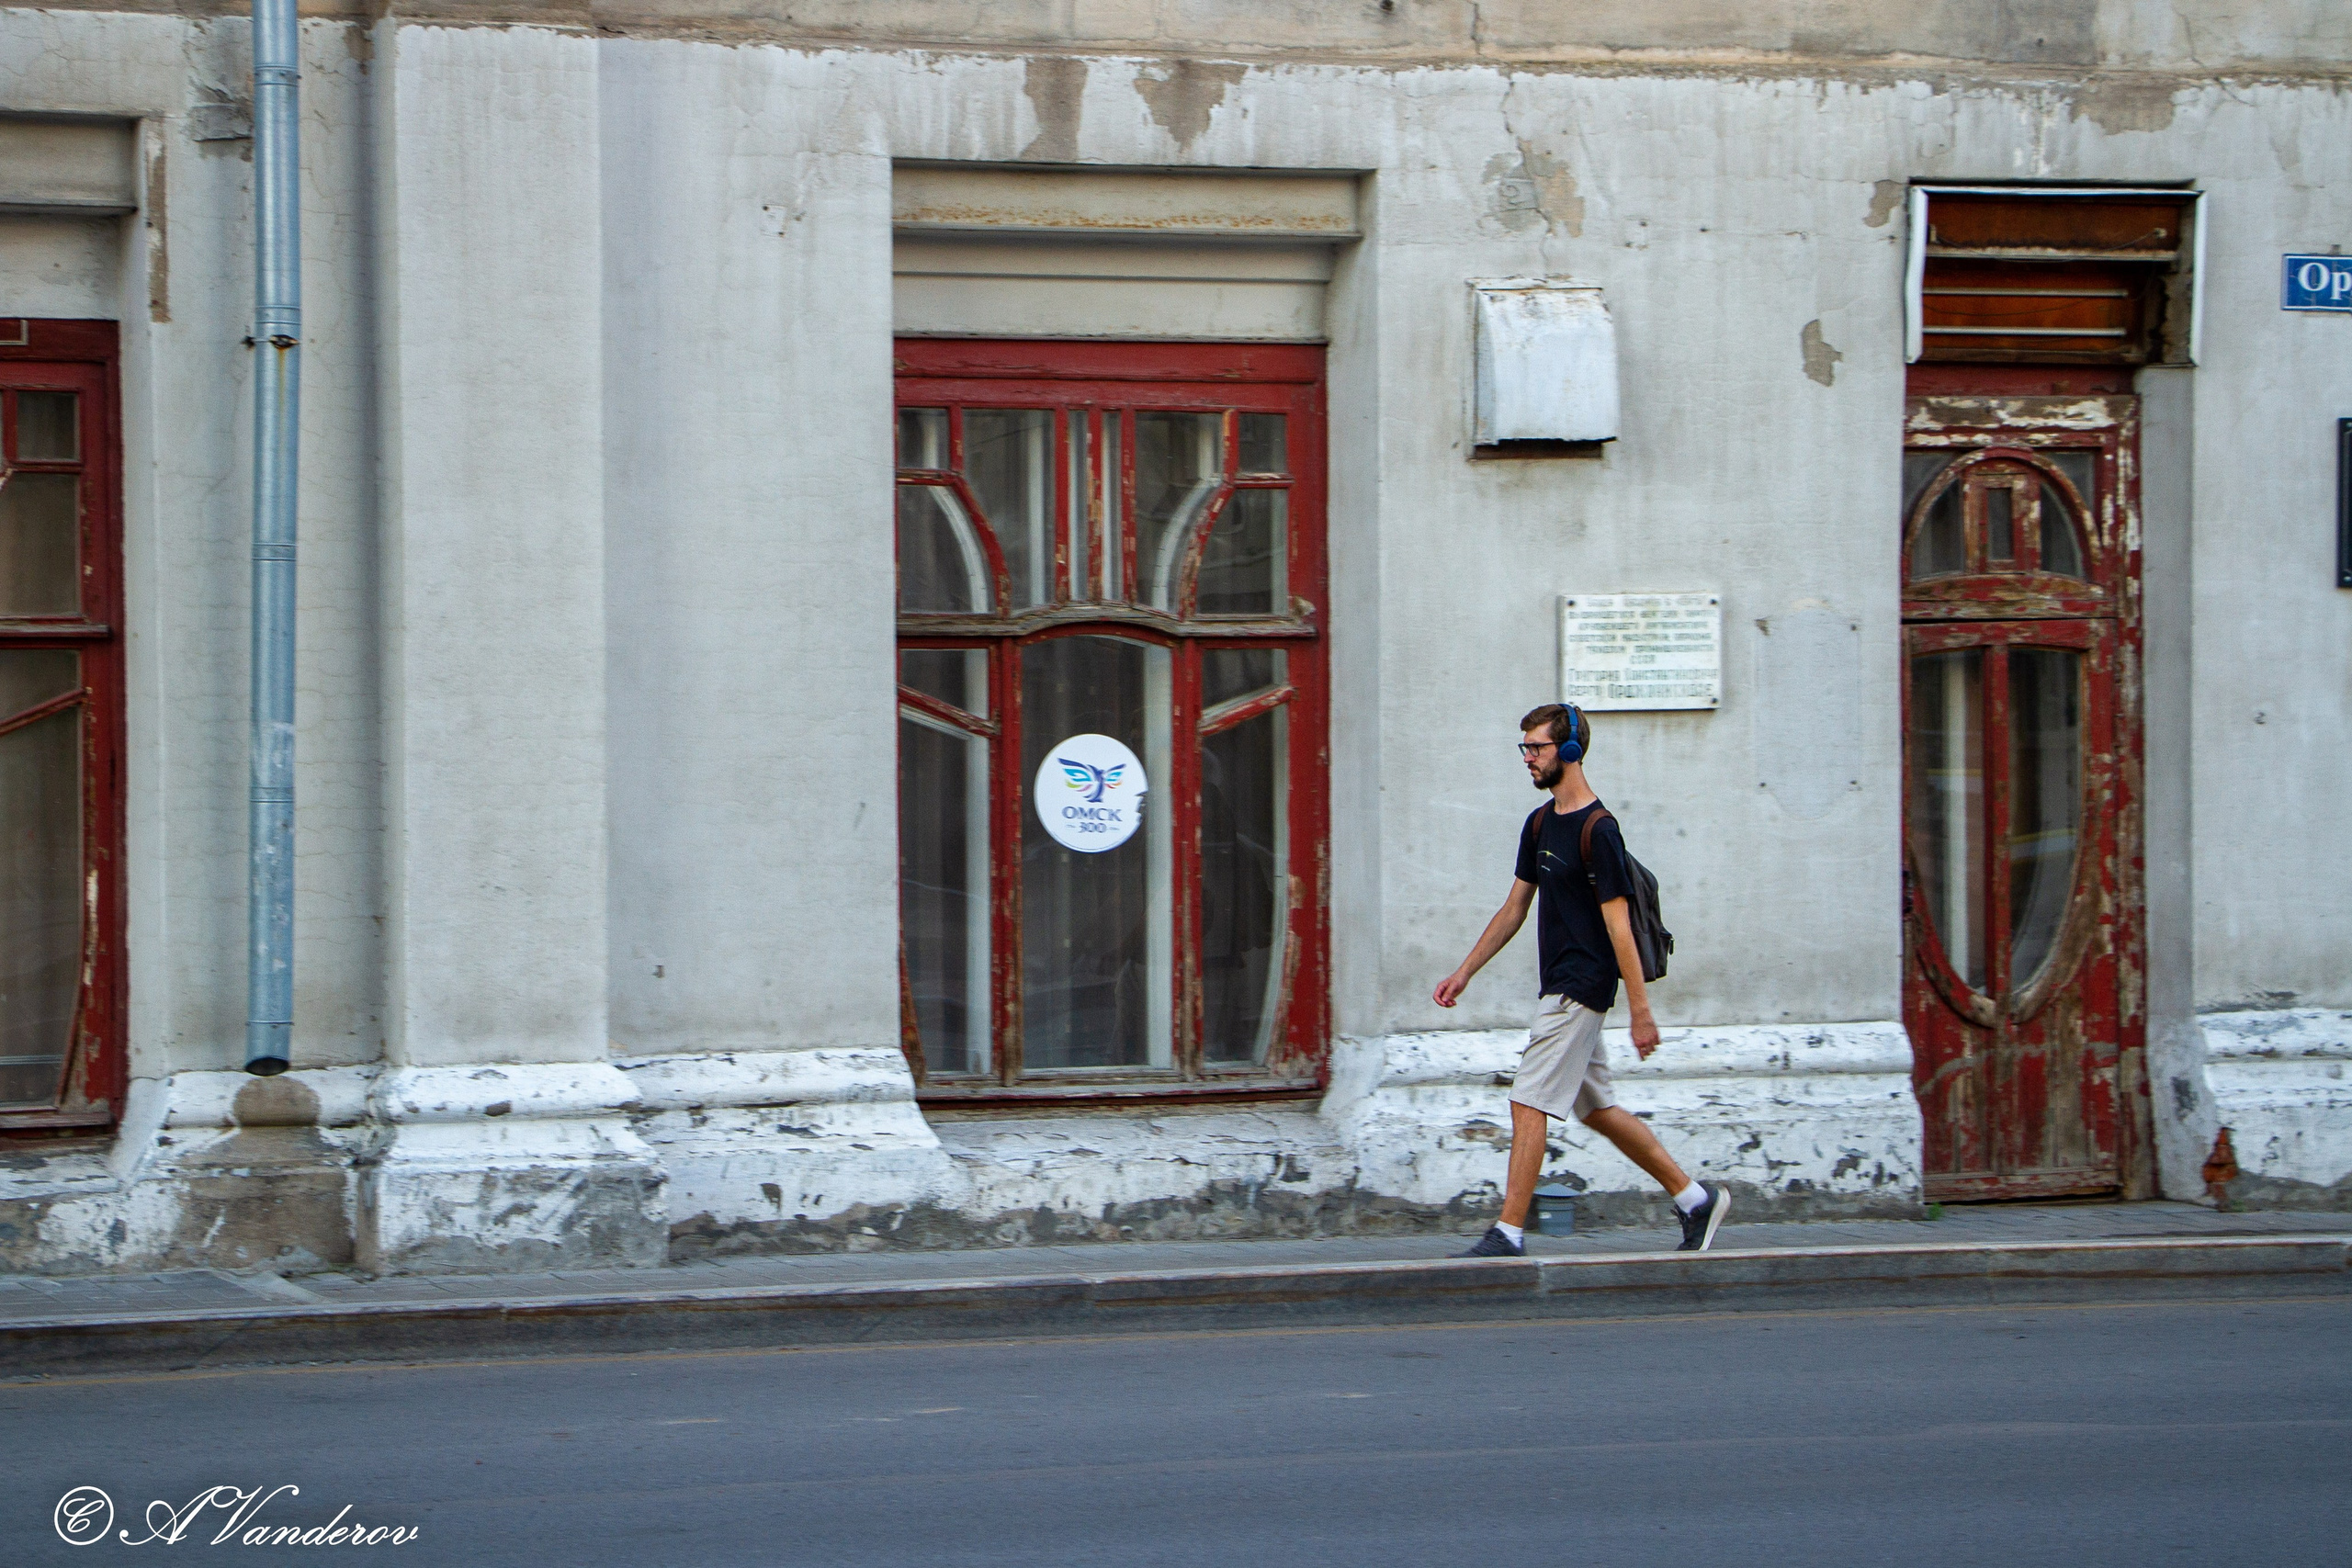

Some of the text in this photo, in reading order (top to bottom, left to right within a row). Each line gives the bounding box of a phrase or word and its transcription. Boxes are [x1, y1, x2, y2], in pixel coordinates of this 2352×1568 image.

[2298, 262, 2352, 300] Ор
[1062, 806, 1123, 821] ОМСК
[1079, 822, 1107, 833] 300
